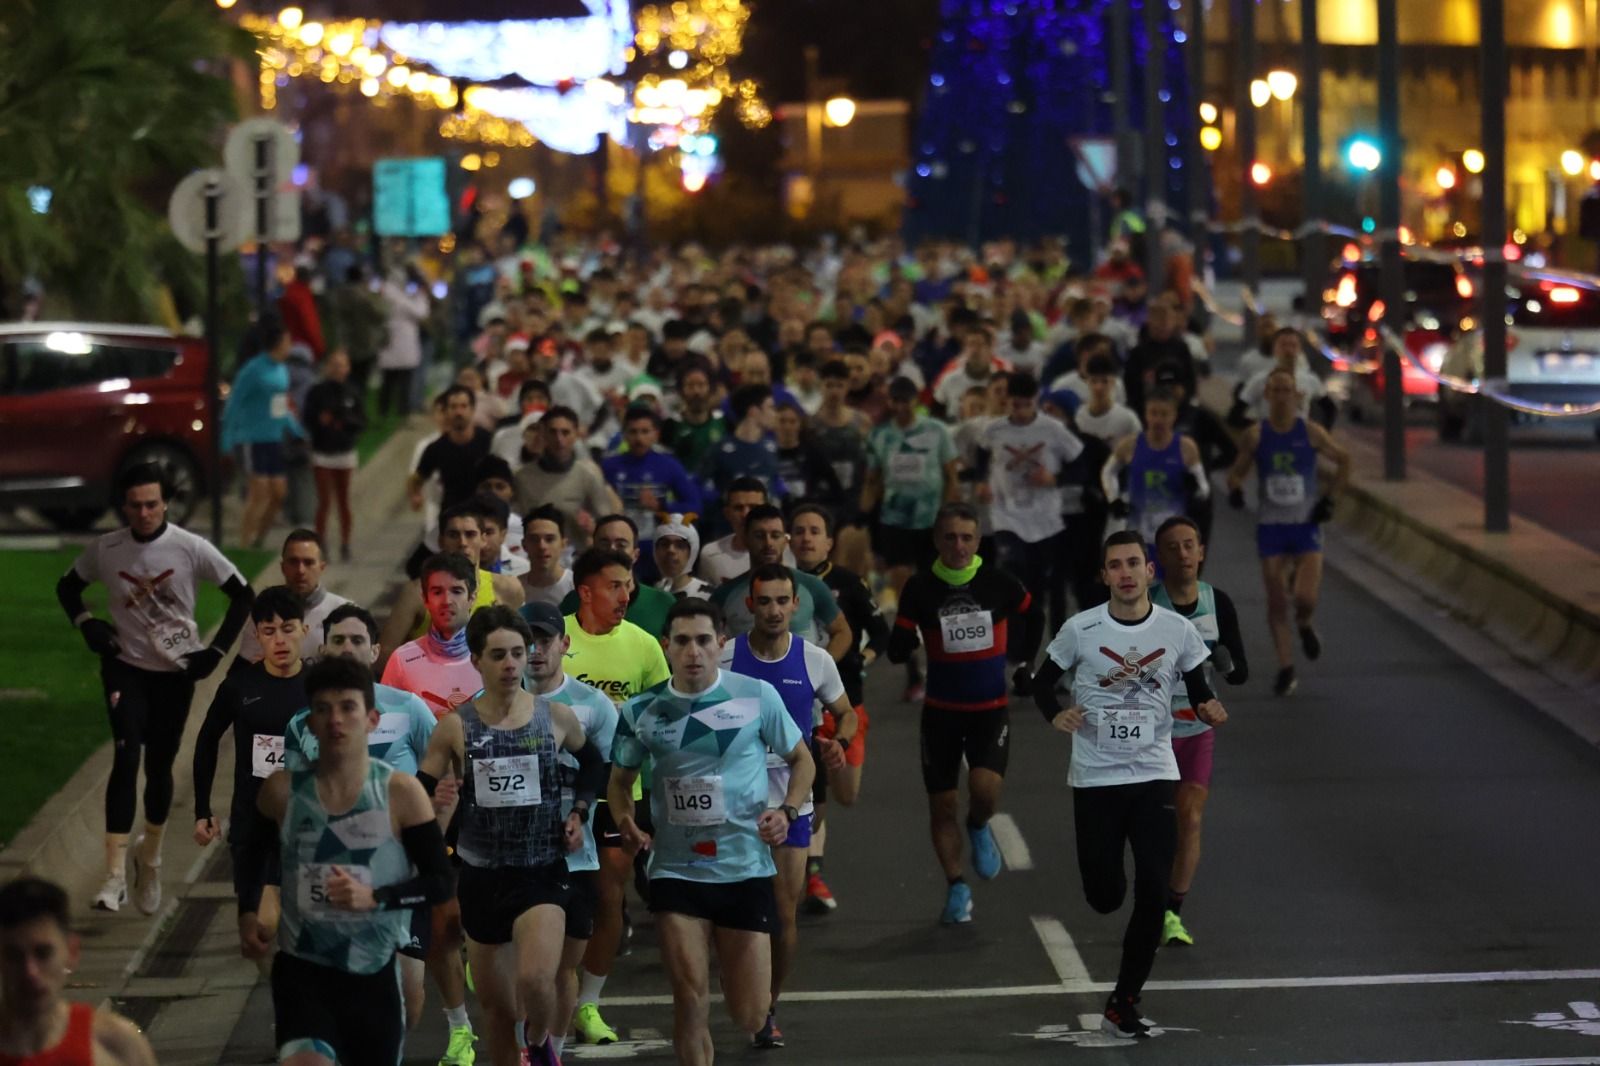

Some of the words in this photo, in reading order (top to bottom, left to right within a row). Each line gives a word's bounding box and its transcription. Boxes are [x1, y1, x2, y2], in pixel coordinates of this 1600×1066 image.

[162, 627, 191, 650] 360
[948, 625, 986, 641] 1059
[1109, 725, 1141, 739] 134
[488, 774, 525, 792] 572
[673, 794, 712, 810] 1149
